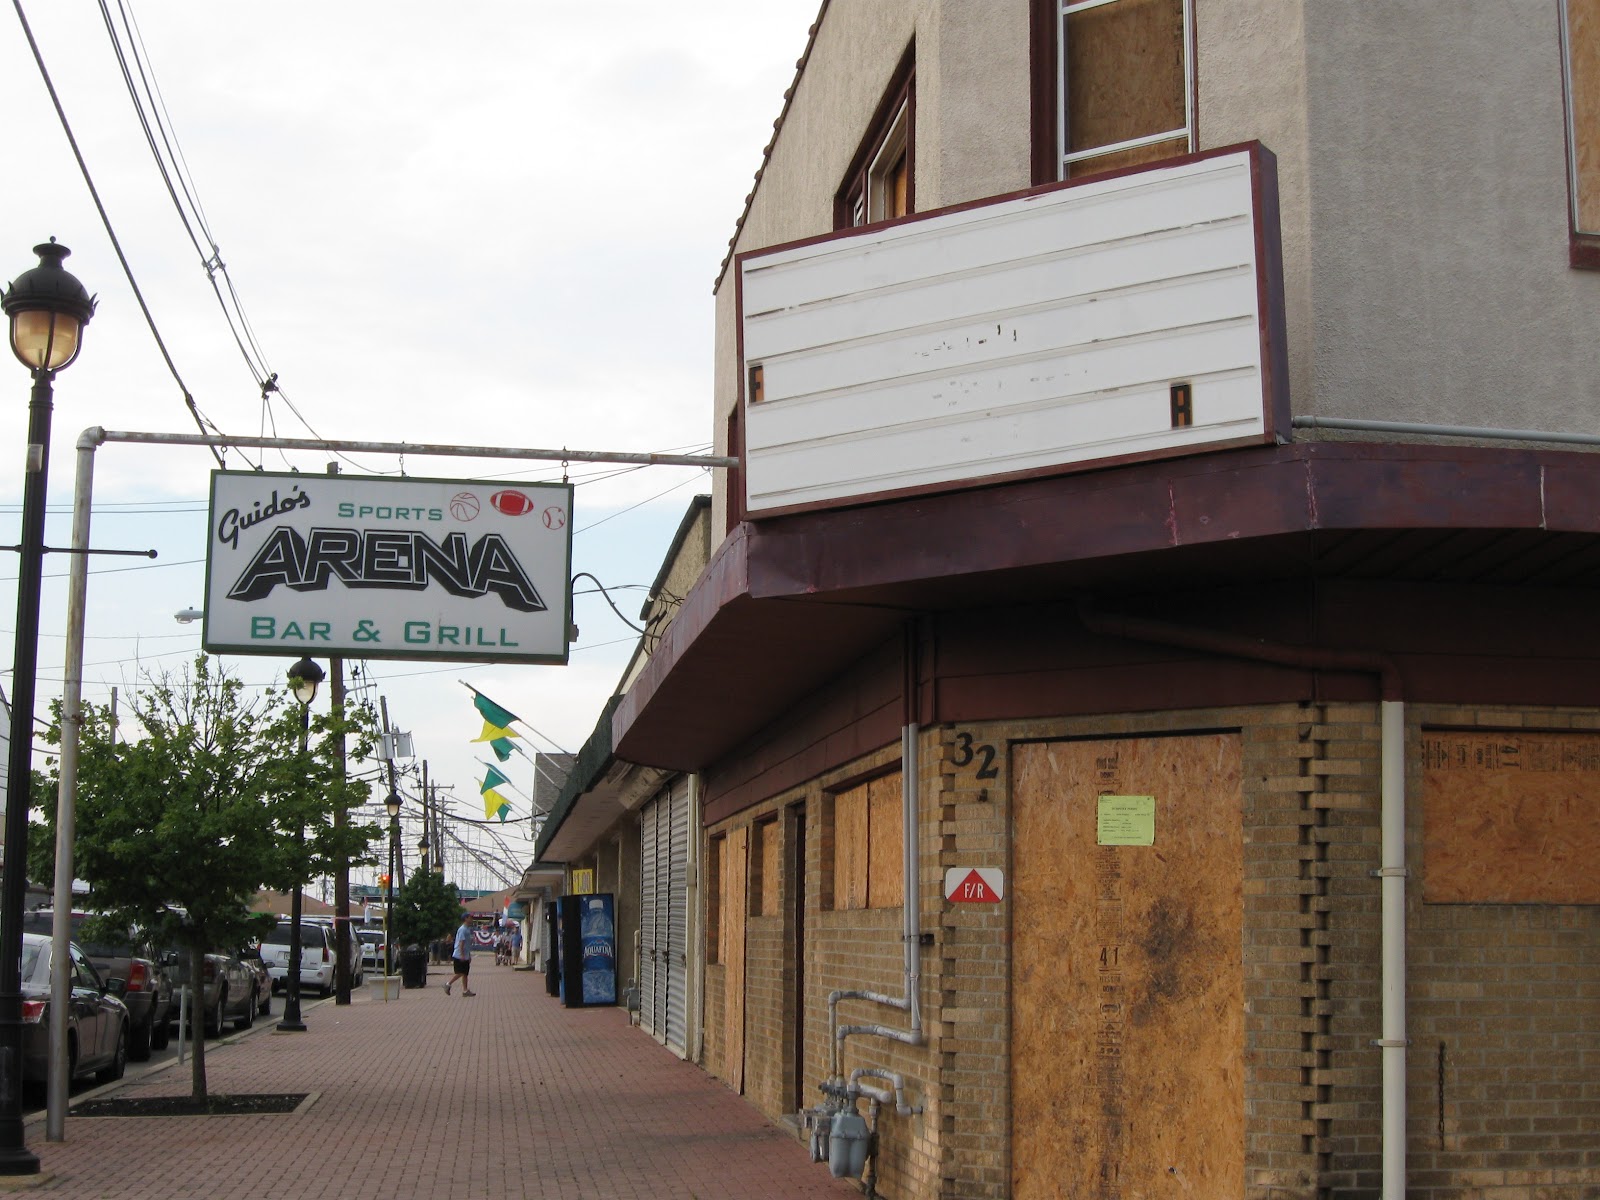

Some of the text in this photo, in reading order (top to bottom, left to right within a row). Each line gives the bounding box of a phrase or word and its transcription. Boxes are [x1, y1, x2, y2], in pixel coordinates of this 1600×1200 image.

[218, 485, 311, 550] Guido's
[338, 502, 443, 521] SPORTS
[225, 526, 548, 613] ARENA
[251, 616, 519, 647] BAR & GRILL
[951, 732, 998, 779] 32
[964, 883, 984, 899] F/R
[584, 945, 613, 958] AQUAFINA
